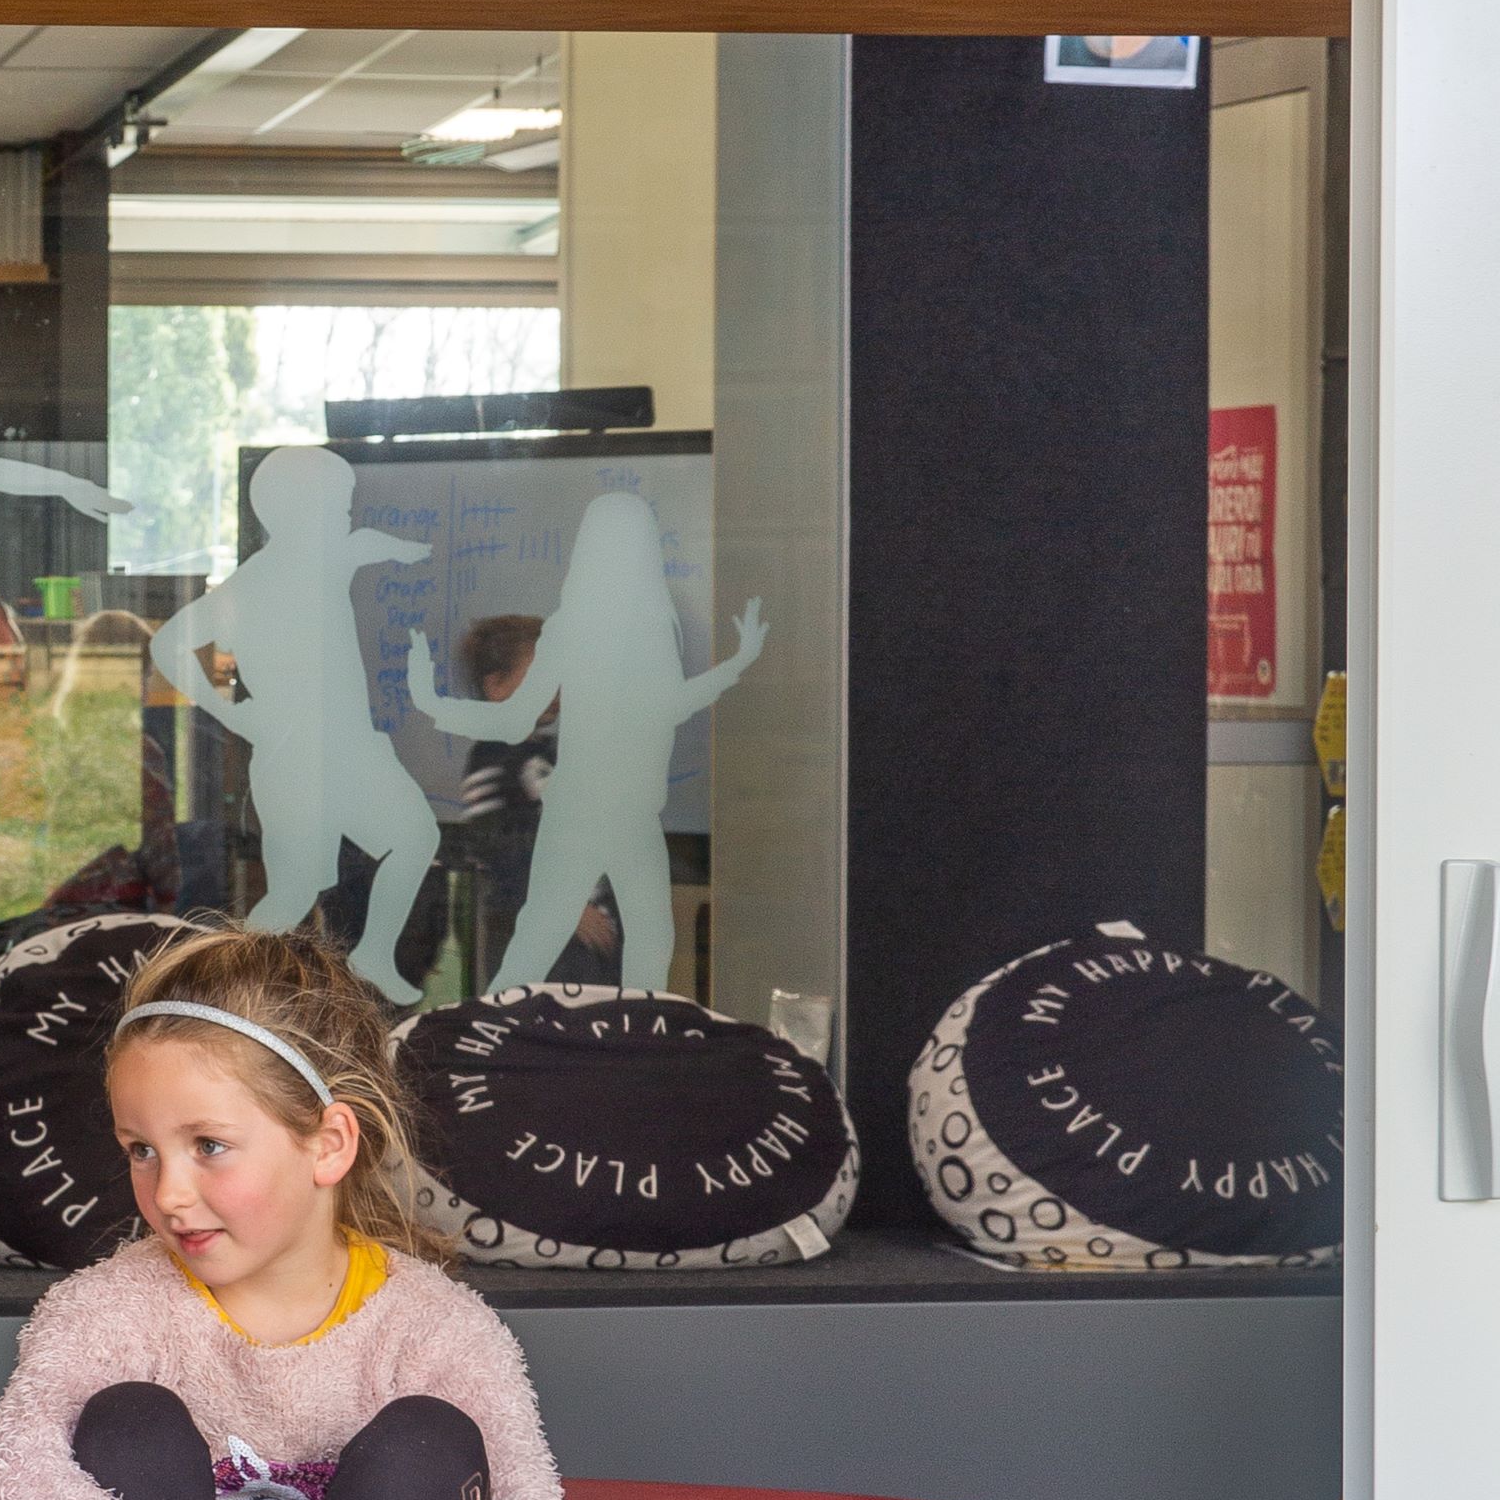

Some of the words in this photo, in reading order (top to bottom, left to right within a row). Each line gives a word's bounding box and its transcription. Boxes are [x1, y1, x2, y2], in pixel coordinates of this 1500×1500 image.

[26, 992, 87, 1047] MY
[1022, 982, 1071, 1026] MY
[1072, 949, 1213, 984] HAPPY
[448, 1073, 495, 1114] MY
[764, 1053, 813, 1104] MY
[695, 1112, 810, 1195] HAPPY
[1027, 1063, 1151, 1176] PLACE
[7, 1096, 99, 1229] PLACE
[505, 1131, 659, 1199] PLACE
[1180, 1151, 1330, 1199] HAPPY
